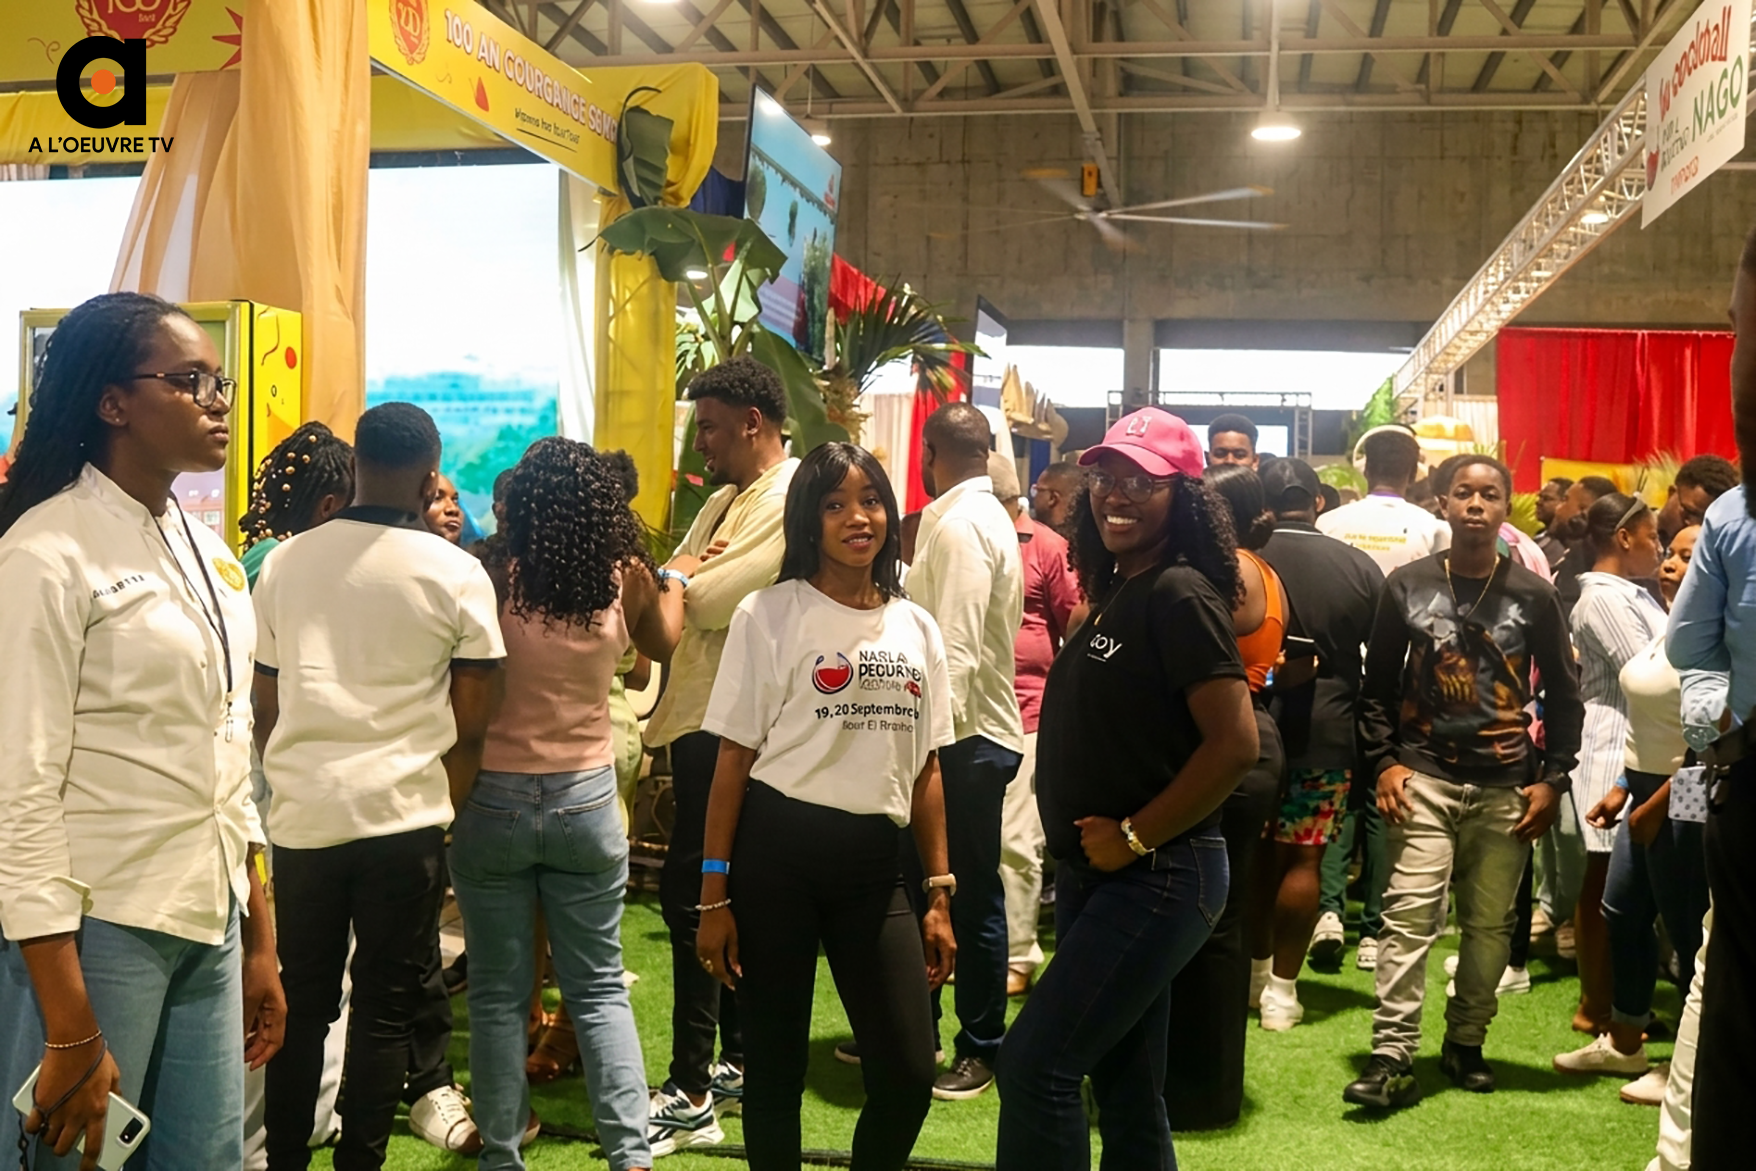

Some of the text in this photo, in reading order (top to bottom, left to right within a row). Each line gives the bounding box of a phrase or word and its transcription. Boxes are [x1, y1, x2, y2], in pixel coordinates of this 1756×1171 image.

[444, 8, 474, 55] 100
[477, 32, 501, 73] AN
[1692, 54, 1743, 142] NAGO
